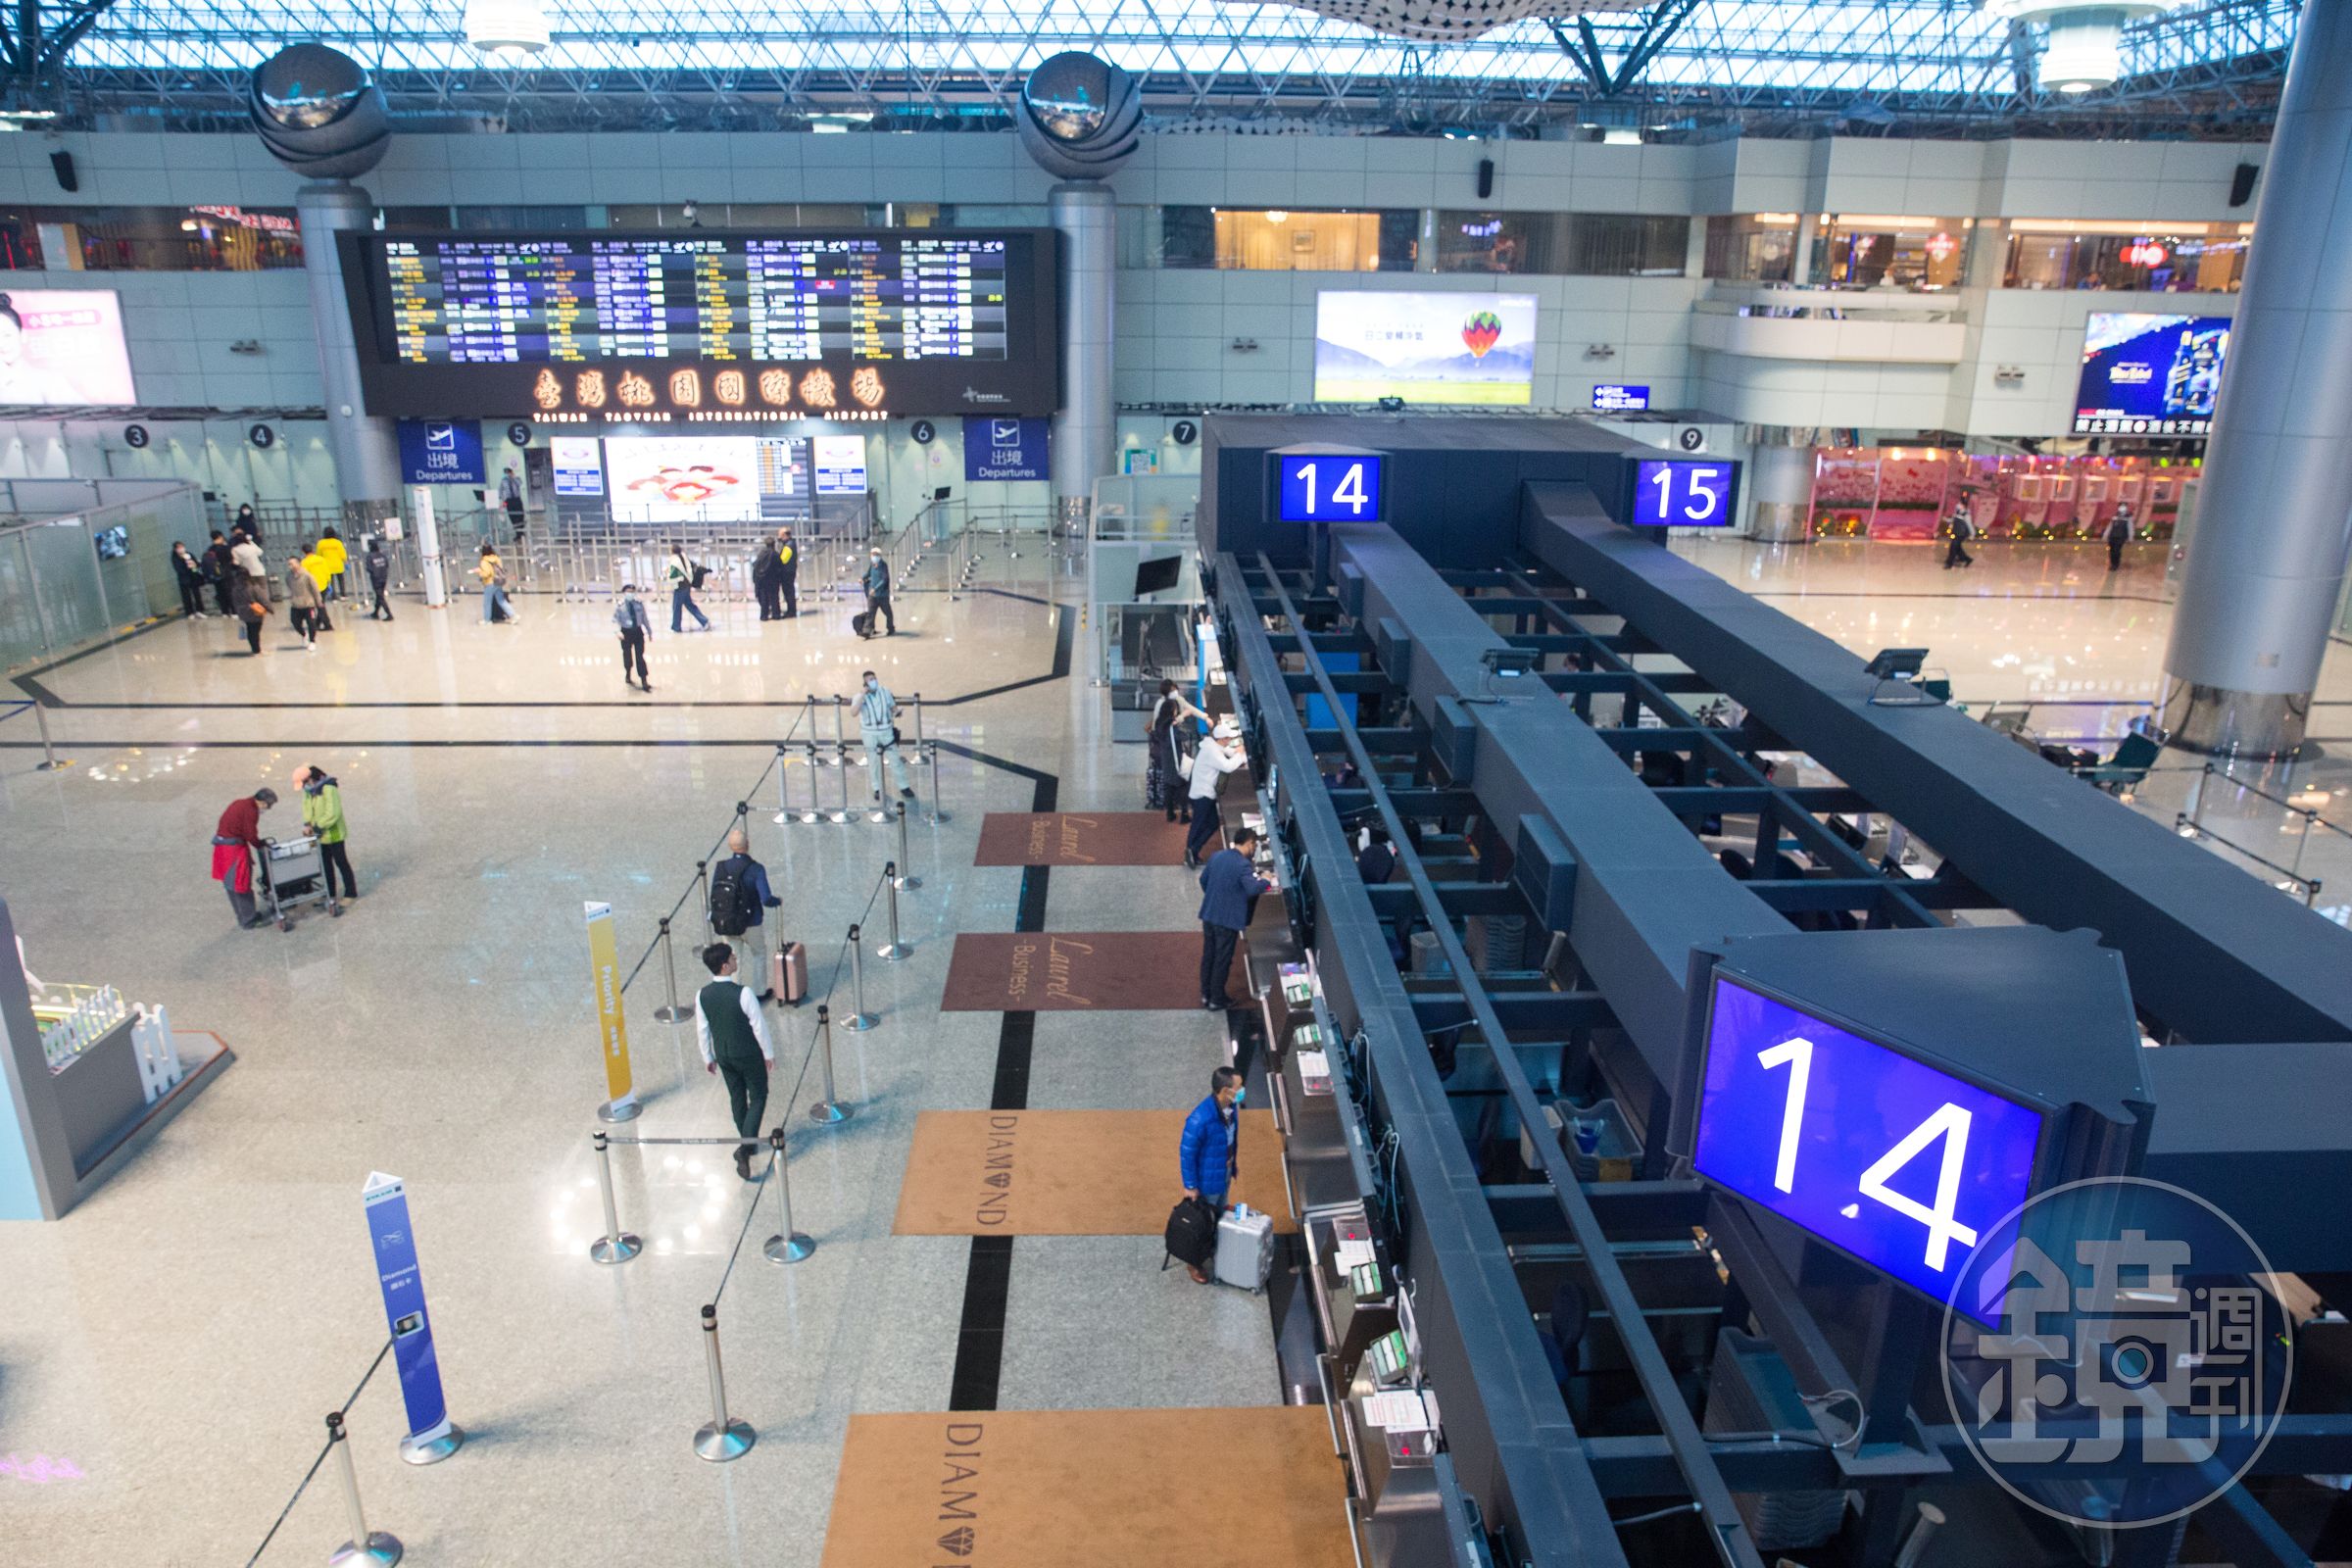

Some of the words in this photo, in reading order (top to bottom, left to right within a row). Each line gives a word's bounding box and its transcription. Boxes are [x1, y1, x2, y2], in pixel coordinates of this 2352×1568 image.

[533, 413, 588, 422] TAIWAN
[605, 412, 671, 422] TAOYUAN
[689, 411, 807, 421] INTERNATIONAL
[824, 411, 888, 421] AIRPORT
[130, 427, 143, 446] 3
[255, 427, 266, 445] 4
[514, 425, 525, 443] 5
[917, 424, 929, 441] 6
[1180, 424, 1191, 441] 7
[1687, 429, 1698, 448] 9
[427, 452, 459, 468] 出境
[992, 450, 1023, 466] 出境
[416, 469, 472, 482] Departures
[978, 466, 1036, 480] Departures
[1297, 464, 1368, 515] 14
[1652, 467, 1718, 519] 15
[1047, 936, 1094, 1005] Laurel
[602, 964, 616, 1015] Priority
[1757, 1036, 1978, 1273] 14
